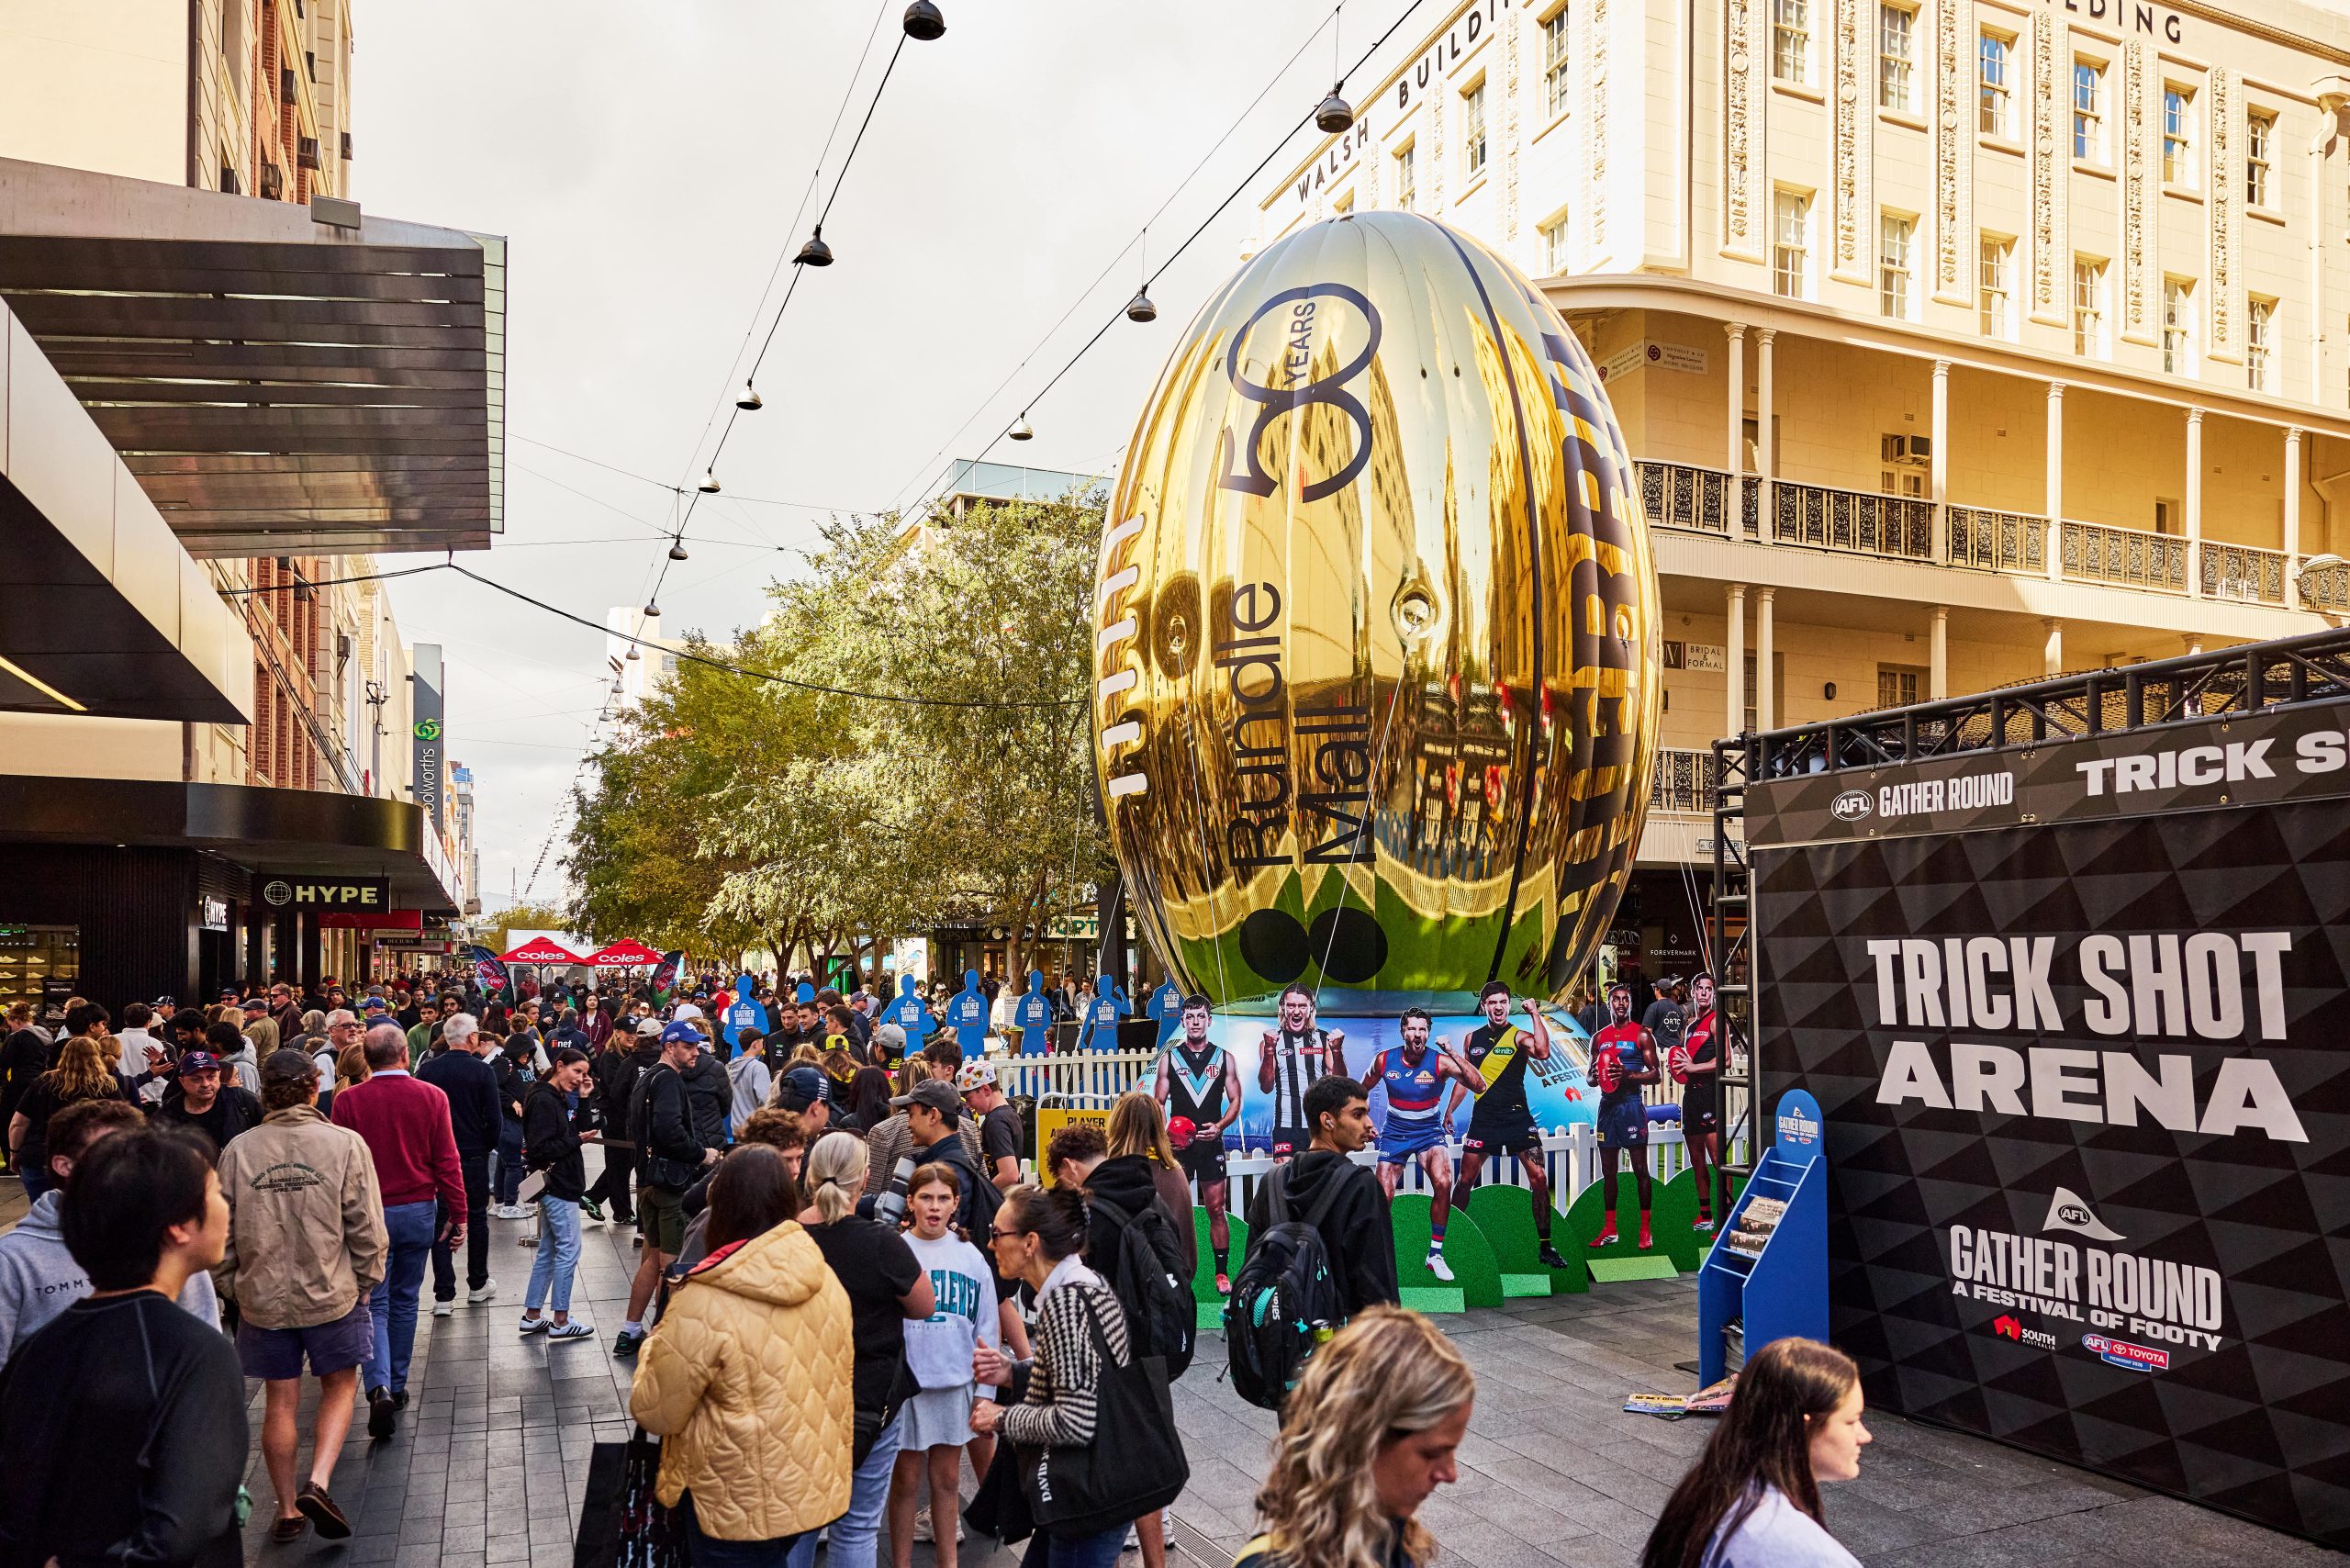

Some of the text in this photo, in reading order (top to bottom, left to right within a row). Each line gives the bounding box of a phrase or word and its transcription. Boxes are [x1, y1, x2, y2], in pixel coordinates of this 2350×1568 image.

[2046, 0, 2181, 44] DING
[1296, 0, 1509, 203] WALSH BUILDI
[1284, 301, 1316, 386] YEARS
[1663, 346, 1689, 355] CONNOLLY
[1690, 645, 1721, 655] BRIDAL
[1687, 659, 1723, 669] FORMAL
[1228, 581, 1293, 868] Rundle
[2076, 730, 2350, 796] TRICK S
[1294, 705, 1377, 865] Mall
[1879, 779, 1945, 818] GATHER
[1948, 771, 2014, 811] ROUND
[296, 885, 377, 903] HYPE
[210, 901, 227, 924] HYPE
[938, 931, 971, 941] OPSM
[517, 951, 566, 960] coles
[598, 953, 644, 963] coles
[1867, 932, 2292, 1041] TRICK SHOT
[1027, 1002, 1044, 1011] GATHER
[1164, 1001, 1179, 1009] ROUND
[735, 1017, 754, 1025] ROUND
[552, 1039, 573, 1048] iinet
[1205, 1066, 1219, 1077] MG
[1875, 1040, 2311, 1143] ARENA
[1068, 1117, 1105, 1127] PLAYER
[2061, 1208, 2088, 1223] AFL
[1950, 1225, 2222, 1330] GATHER ROUND
[34, 1278, 90, 1296] TOMM
[1952, 1281, 2222, 1352] A FESTIVAL OF FOOTY
[2021, 1328, 2055, 1345] SOUTH
[2021, 1338, 2055, 1350] AUSTRALIA
[2085, 1338, 2165, 1364] AFL TOYOTA
[1037, 1462, 1053, 1503] DAVID
